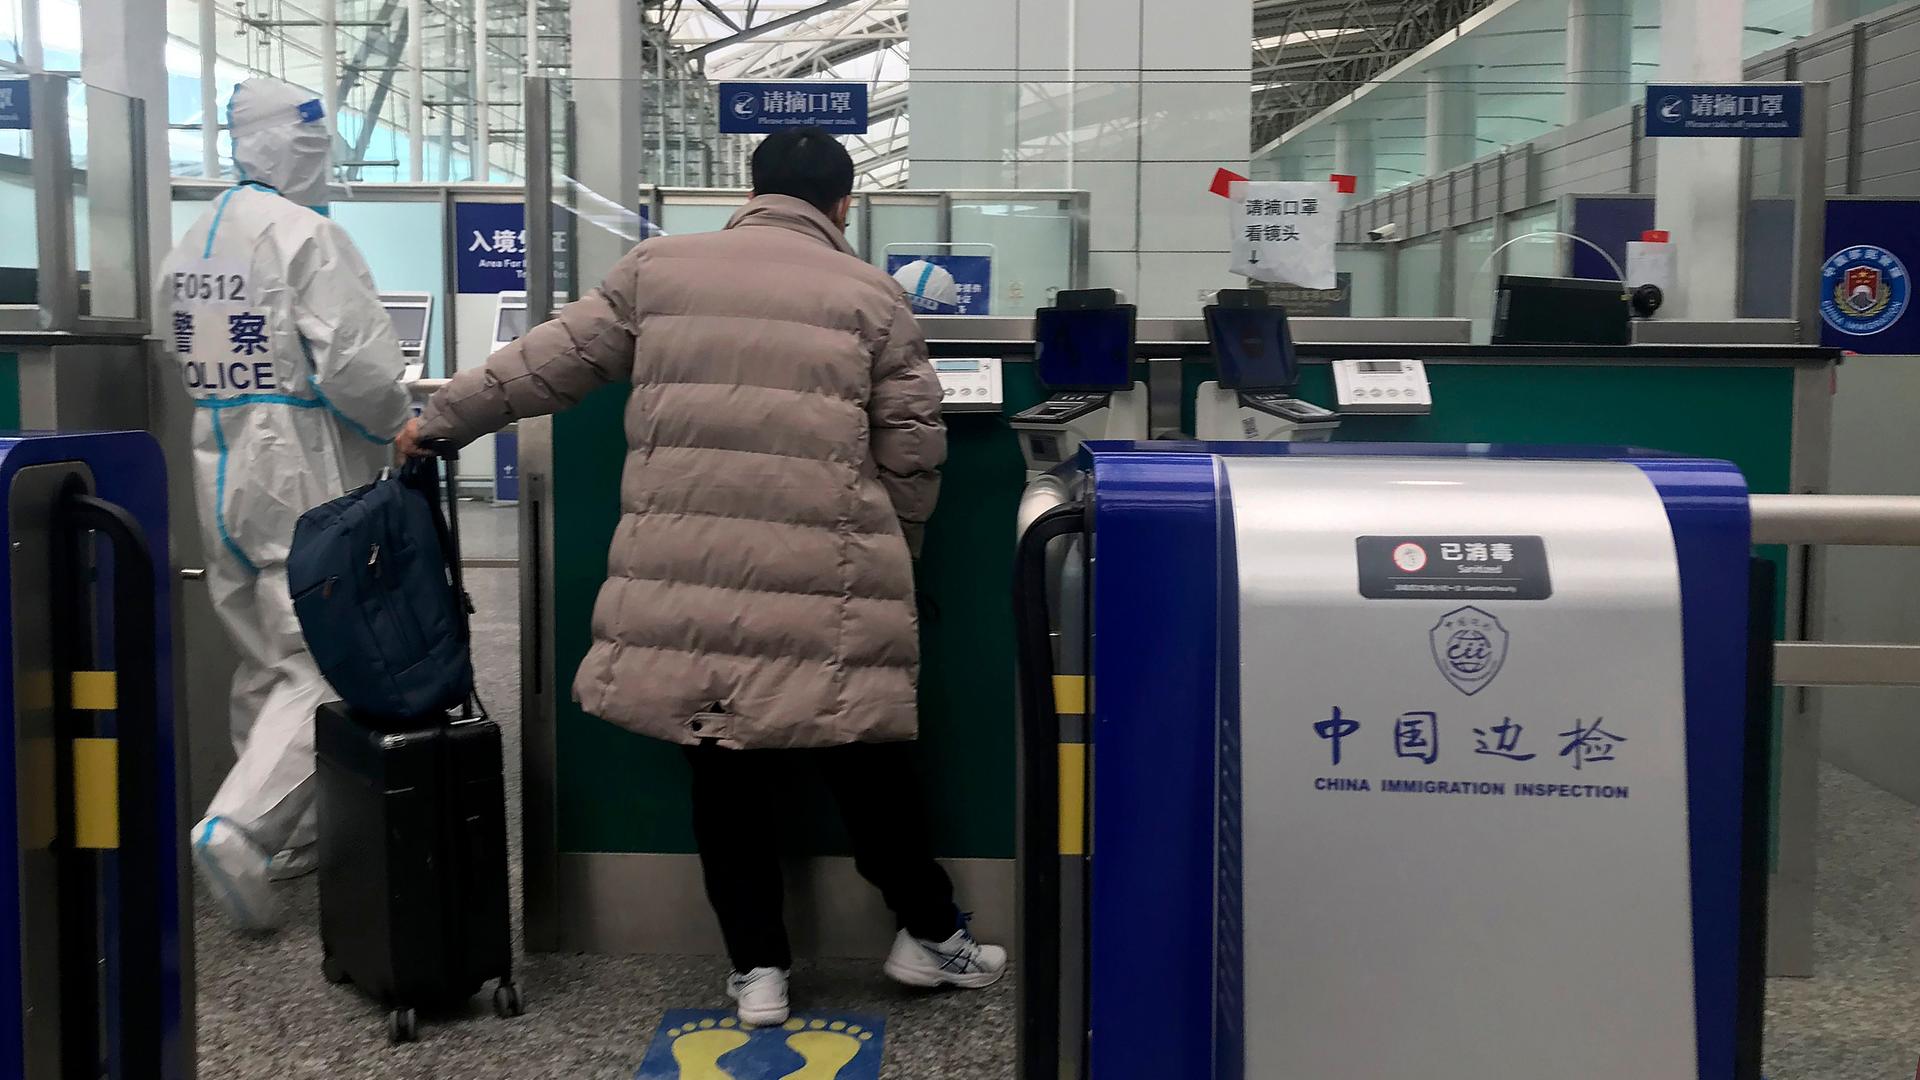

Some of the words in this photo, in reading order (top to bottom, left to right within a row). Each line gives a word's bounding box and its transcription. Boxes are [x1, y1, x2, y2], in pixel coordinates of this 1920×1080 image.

[763, 90, 851, 113] 请摘口罩
[1691, 94, 1783, 116] 请摘口罩
[758, 116, 783, 125] Please
[784, 117, 800, 125] take
[801, 116, 816, 125] off
[816, 118, 833, 127] your
[835, 117, 857, 125] mask
[1685, 120, 1711, 128] Please
[1764, 120, 1789, 128] mask
[1246, 198, 1319, 216] 请摘口罩
[1245, 224, 1300, 241] 看镜头
[478, 259, 502, 268] Area
[504, 259, 521, 268] For
[173, 310, 269, 355] 警察
[183, 361, 277, 390] OLICE
[1440, 542, 1515, 562] 已消毒
[1457, 564, 1503, 574] Sanitized
[1313, 705, 1628, 771] 中国边检
[1314, 777, 1371, 792] CHINA
[1381, 779, 1506, 796] IMMIGRATION
[1514, 782, 1630, 799] INSPECTION
